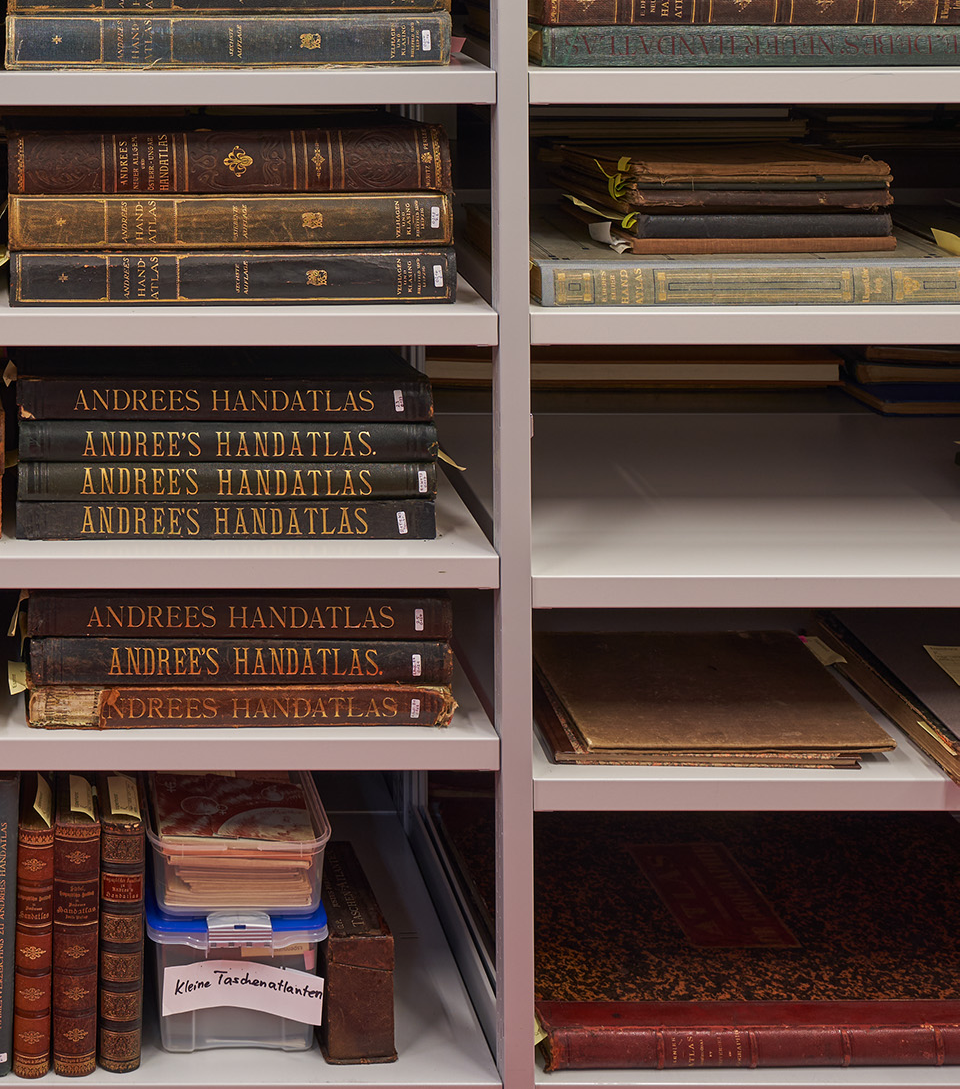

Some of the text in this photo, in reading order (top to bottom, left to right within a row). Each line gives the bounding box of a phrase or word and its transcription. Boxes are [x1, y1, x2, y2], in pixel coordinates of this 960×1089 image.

[565, 35, 736, 55] HANDATLAS
[120, 141, 128, 185] ANDREES
[158, 134, 169, 191] HANDATLAS
[148, 200, 157, 243] ATLAS
[151, 257, 159, 299] ATLAS
[73, 389, 200, 411] ANDREES
[211, 389, 375, 412] HANDATLAS
[82, 431, 377, 457] ANDREE'S HANDATLAS.
[80, 467, 373, 497] ANDREE'S HANDATLAS
[80, 506, 369, 535] ANDREE'S HANDATLAS
[86, 605, 217, 629] ANDREES
[229, 606, 395, 629] HANDATLAS
[108, 647, 219, 676] ANDREE'S
[234, 647, 383, 676] HANDATLAS.
[231, 696, 397, 719] HANDATLAS
[0, 823, 8, 877] HANDATLAS
[174, 970, 322, 1000] Kleine Taschenatlanten
